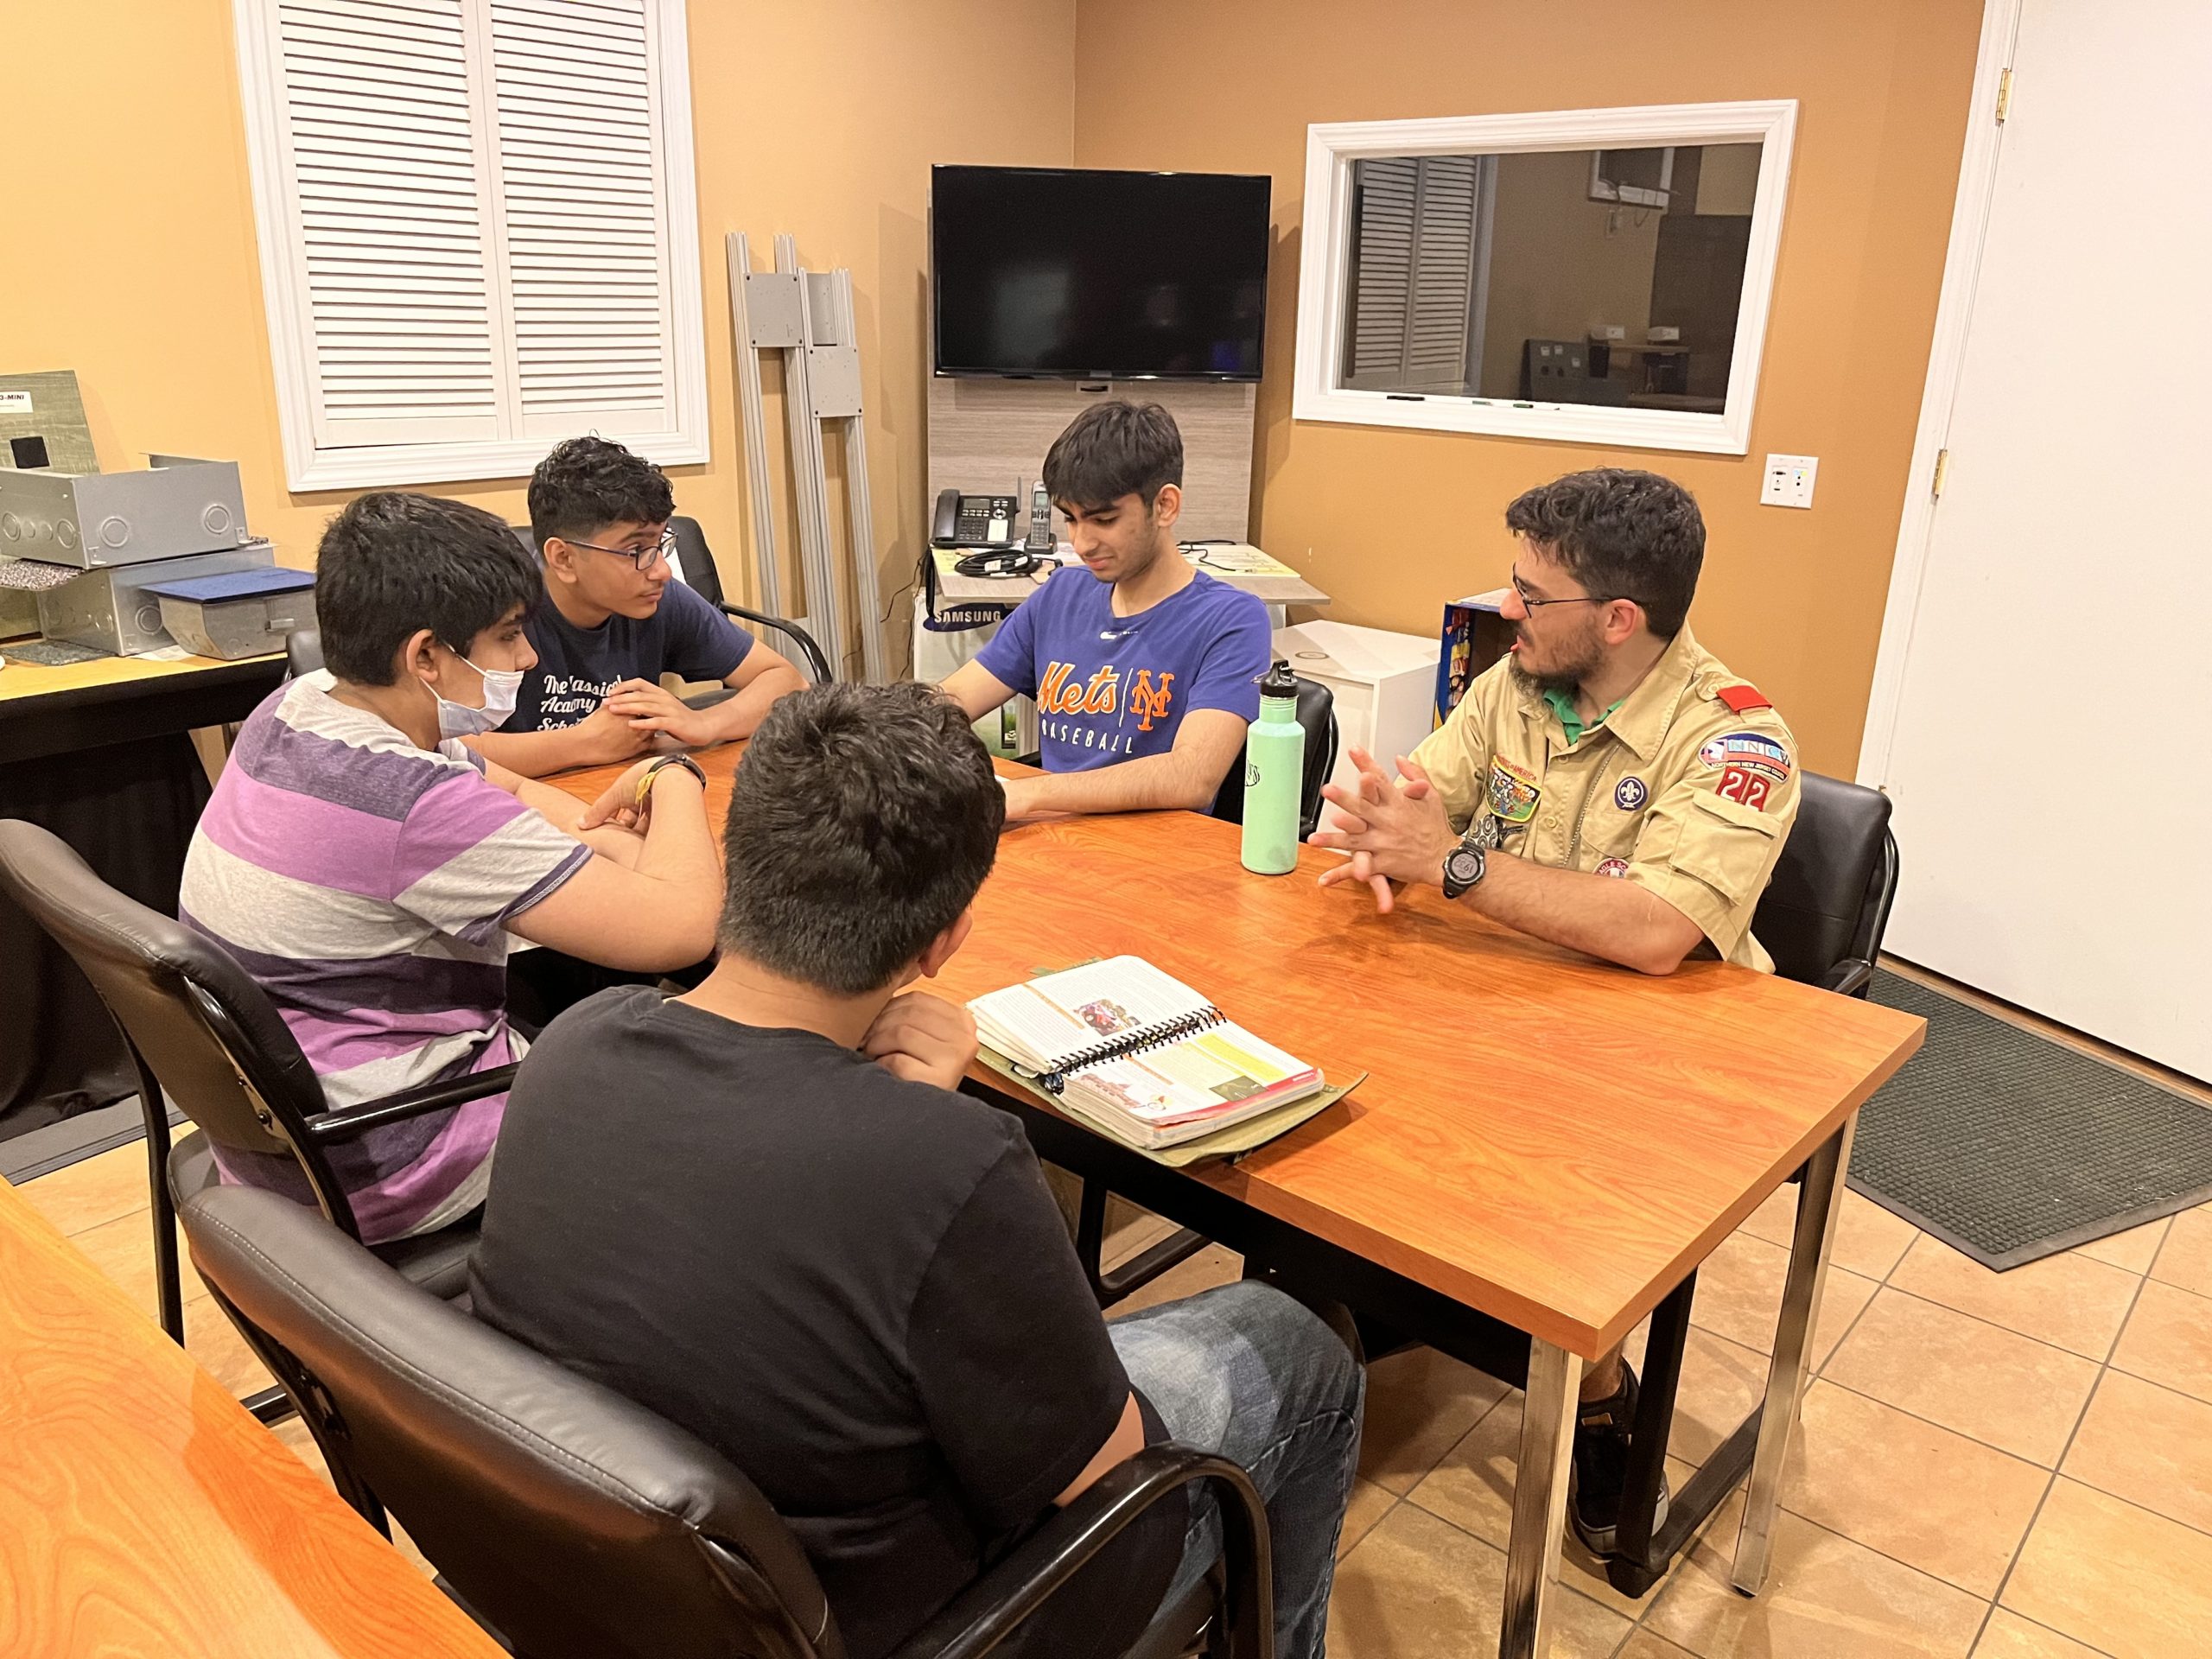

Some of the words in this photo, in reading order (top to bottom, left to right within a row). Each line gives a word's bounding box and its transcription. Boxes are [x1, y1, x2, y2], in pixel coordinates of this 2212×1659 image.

[934, 610, 1001, 623] SAMSUNG
[543, 674, 569, 695] The
[1037, 661, 1121, 715] Mets
[1041, 718, 1133, 753] BASEBALL
[1598, 861, 1616, 874] AGLE
